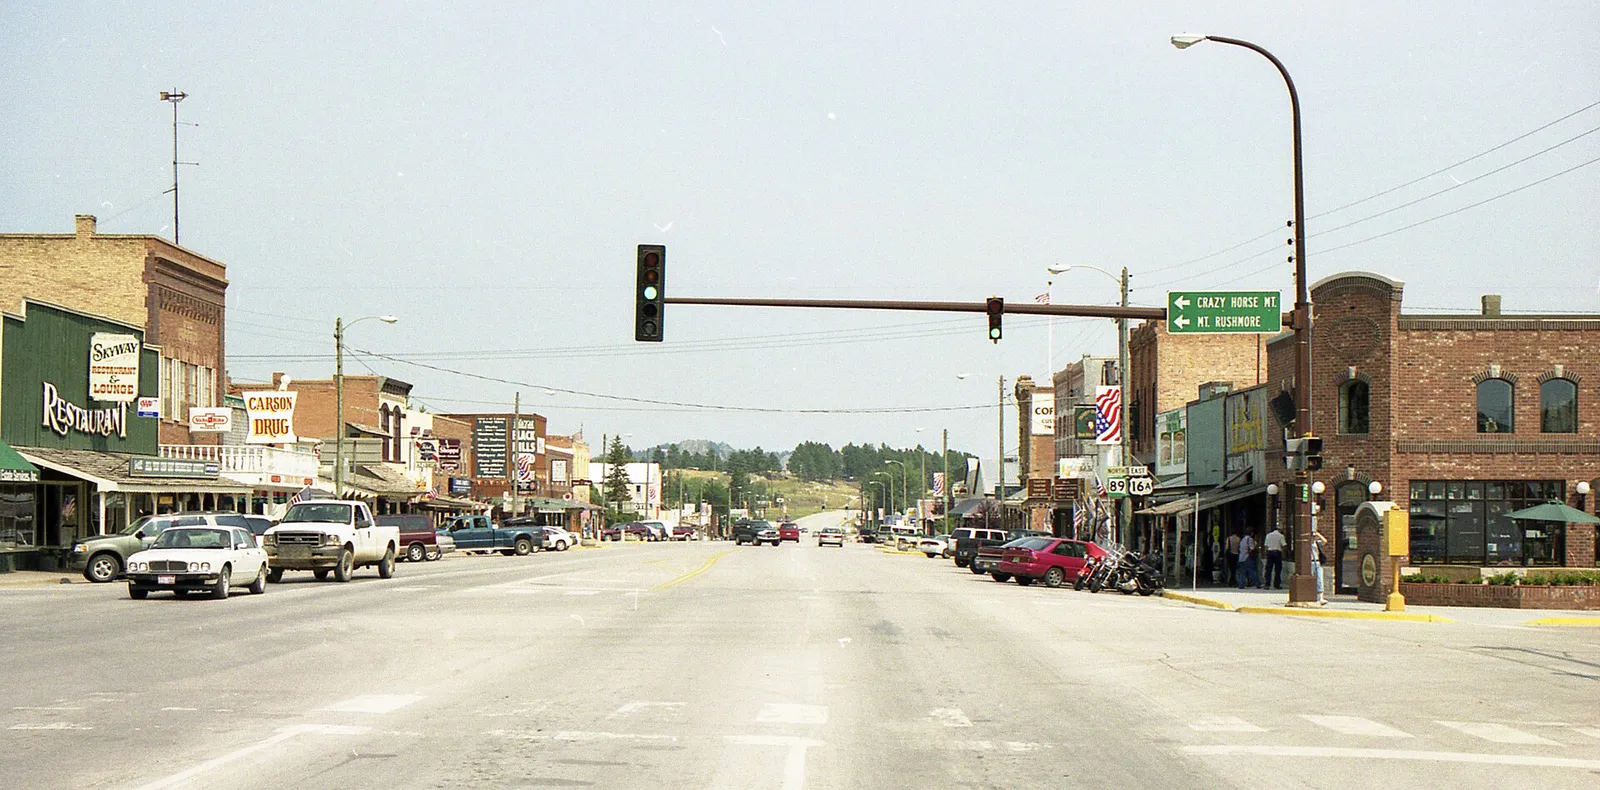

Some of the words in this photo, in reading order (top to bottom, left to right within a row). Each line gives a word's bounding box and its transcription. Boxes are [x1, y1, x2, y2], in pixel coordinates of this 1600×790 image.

[1197, 296, 1226, 308] CRAZY
[1231, 296, 1258, 308] HORSE
[1264, 296, 1277, 308] MT.
[1197, 316, 1210, 328] MT.
[1215, 316, 1261, 328] RUSHMORE
[93, 343, 138, 361] SKYWAY
[109, 375, 120, 383] &
[93, 384, 134, 395] LOUNGE
[42, 381, 130, 437] RESTAURANT
[248, 396, 293, 412] CARSON
[254, 418, 290, 437] DRUG
[1110, 480, 1125, 492] 89
[1131, 480, 1151, 492] 16A
